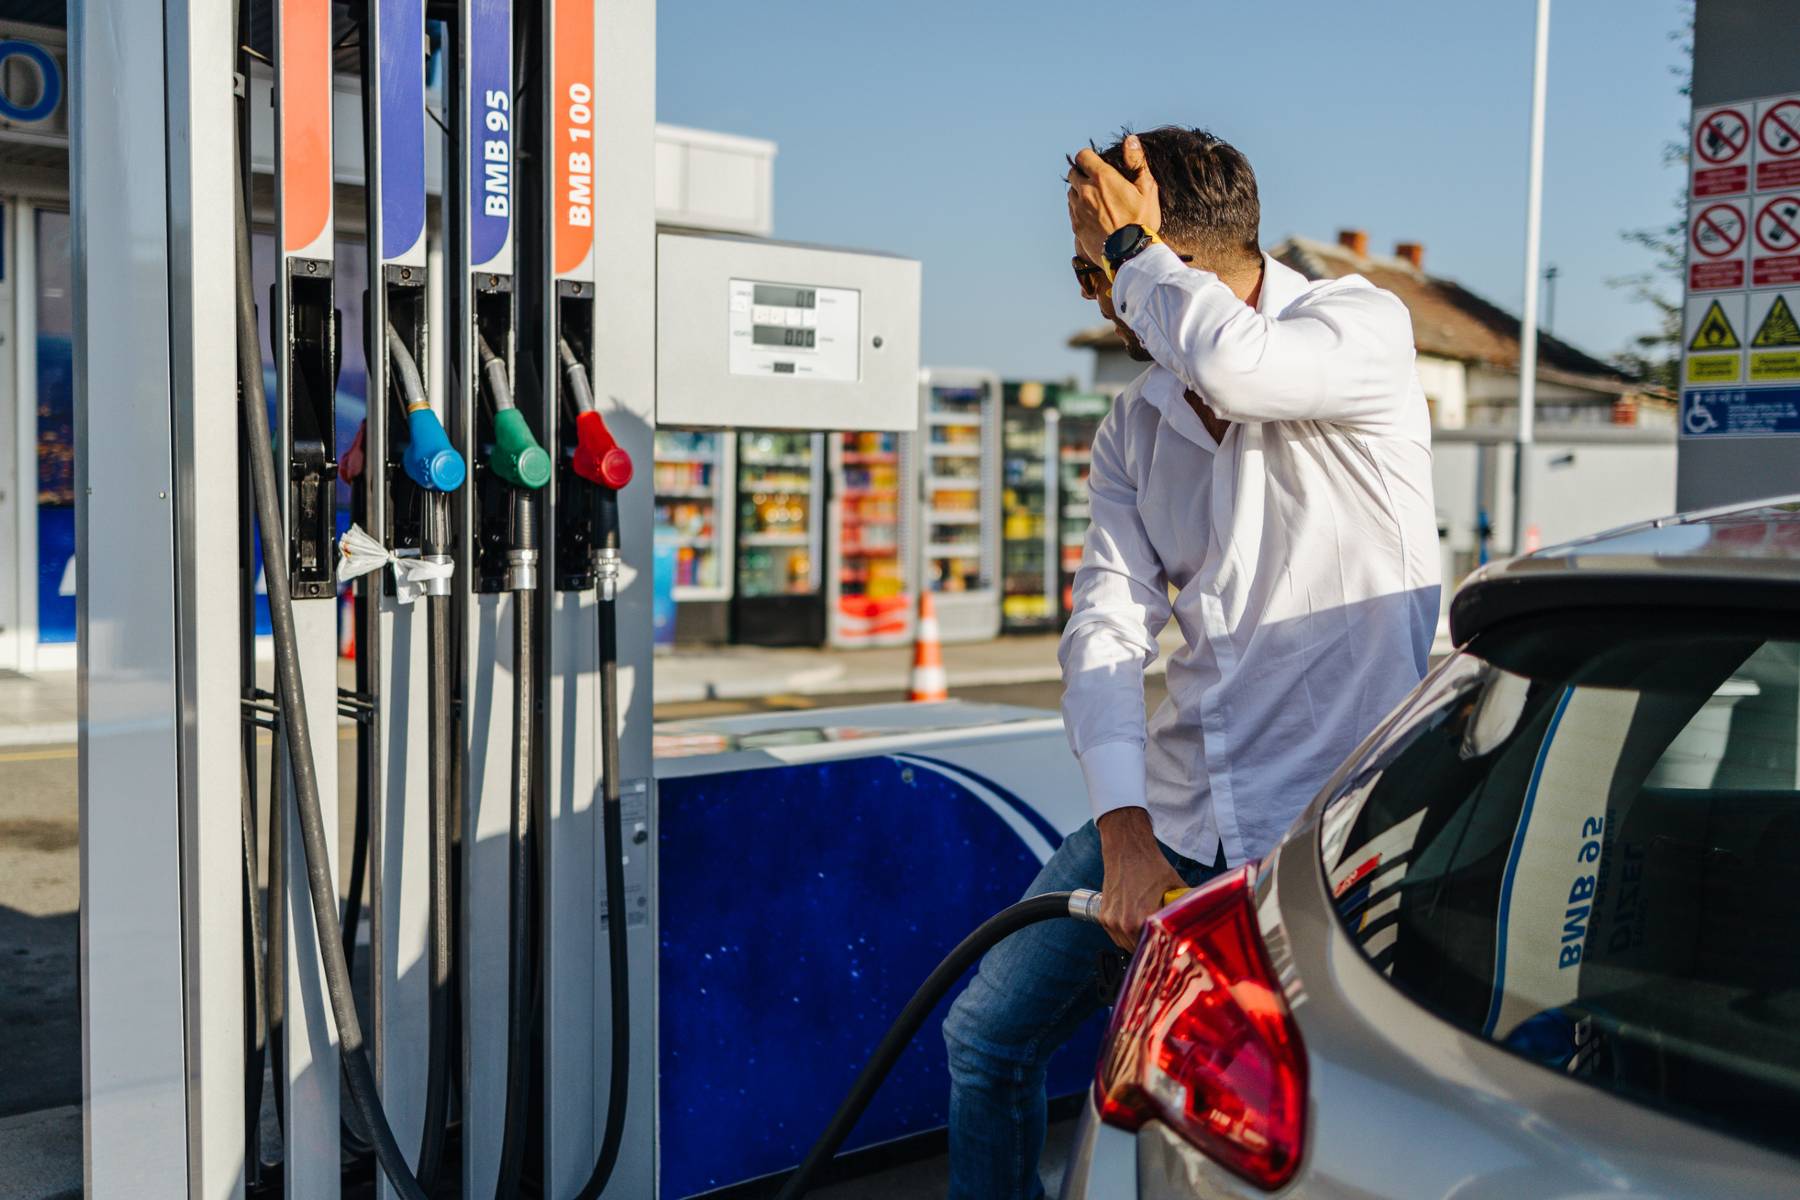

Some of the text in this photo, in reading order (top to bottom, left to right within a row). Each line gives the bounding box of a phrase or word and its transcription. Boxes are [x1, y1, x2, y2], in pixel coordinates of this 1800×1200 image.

[485, 90, 509, 217] BMB 95
[568, 83, 591, 227] BMB 100
